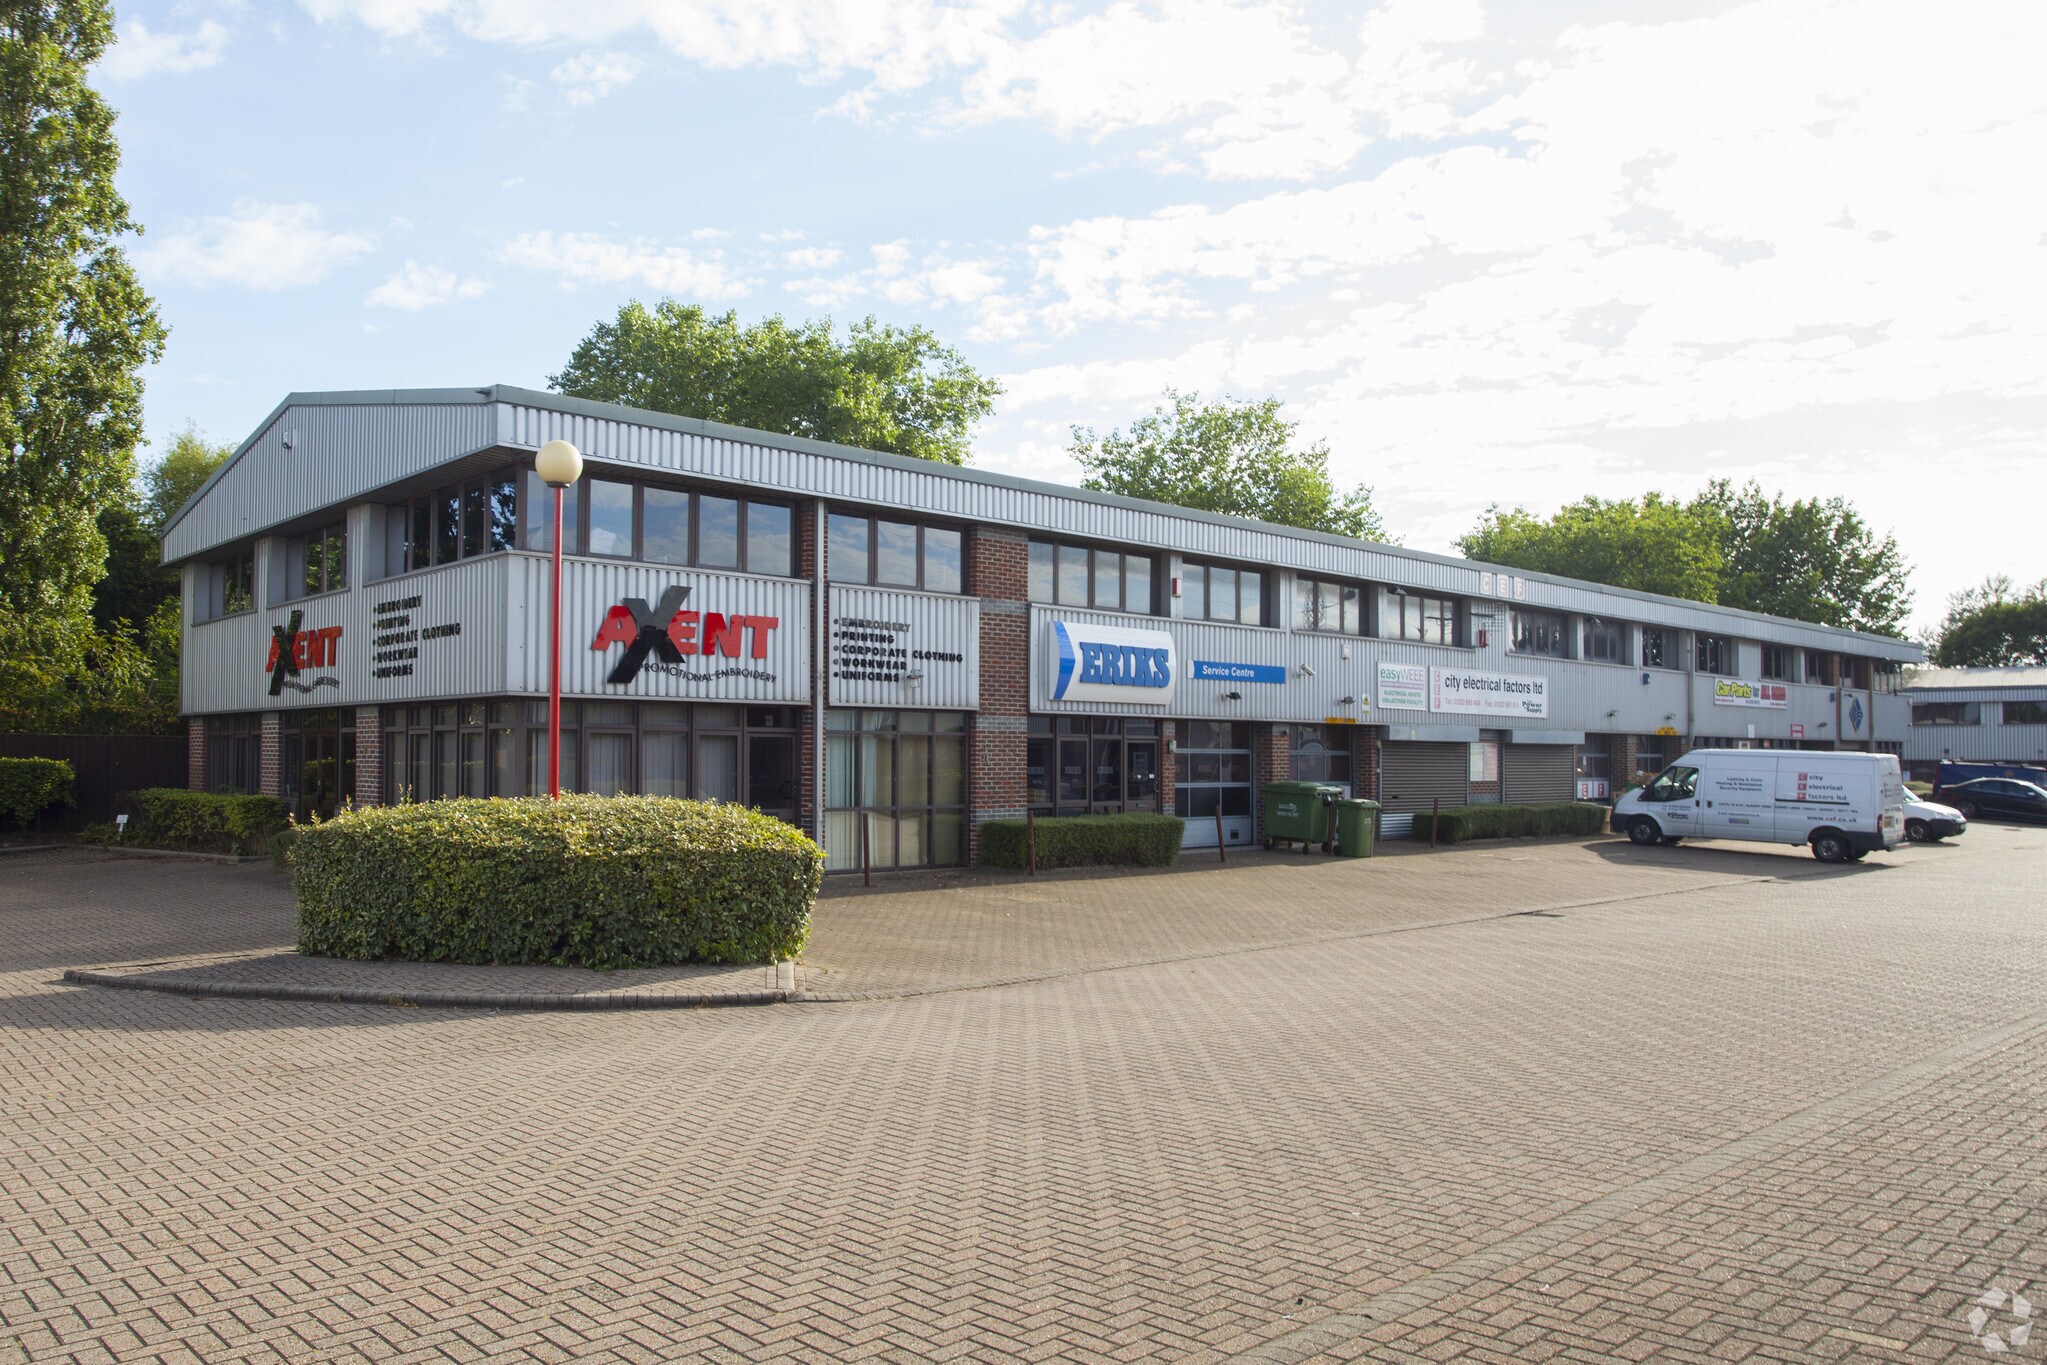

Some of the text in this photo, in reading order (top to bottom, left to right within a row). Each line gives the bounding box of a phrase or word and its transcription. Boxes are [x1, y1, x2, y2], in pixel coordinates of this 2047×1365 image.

[377, 595, 422, 614] EMBROIDERY
[377, 615, 411, 630] PRINTING
[841, 618, 911, 633] EMBROIDERY
[377, 623, 461, 647] CORPORATE CLOTHING
[591, 585, 779, 683] AXENT
[841, 631, 895, 644] PRINTING
[266, 610, 341, 696] AXENT
[377, 647, 418, 663] WORKWEAR
[841, 644, 963, 663] CORPORATE CLOTHING
[377, 664, 413, 679] UNIFORMS
[841, 658, 907, 671] WORKWEAR
[1079, 641, 1171, 689] ERIKS
[1202, 665, 1255, 678] Service Centre
[714, 668, 777, 684] EMBROIDERY
[841, 670, 900, 683] UNIFORMS
[1445, 674, 1543, 695] city electrical factors ltd
[1836, 793, 1847, 801] ltd
[1807, 815, 1857, 823] www.cef.co.uk
